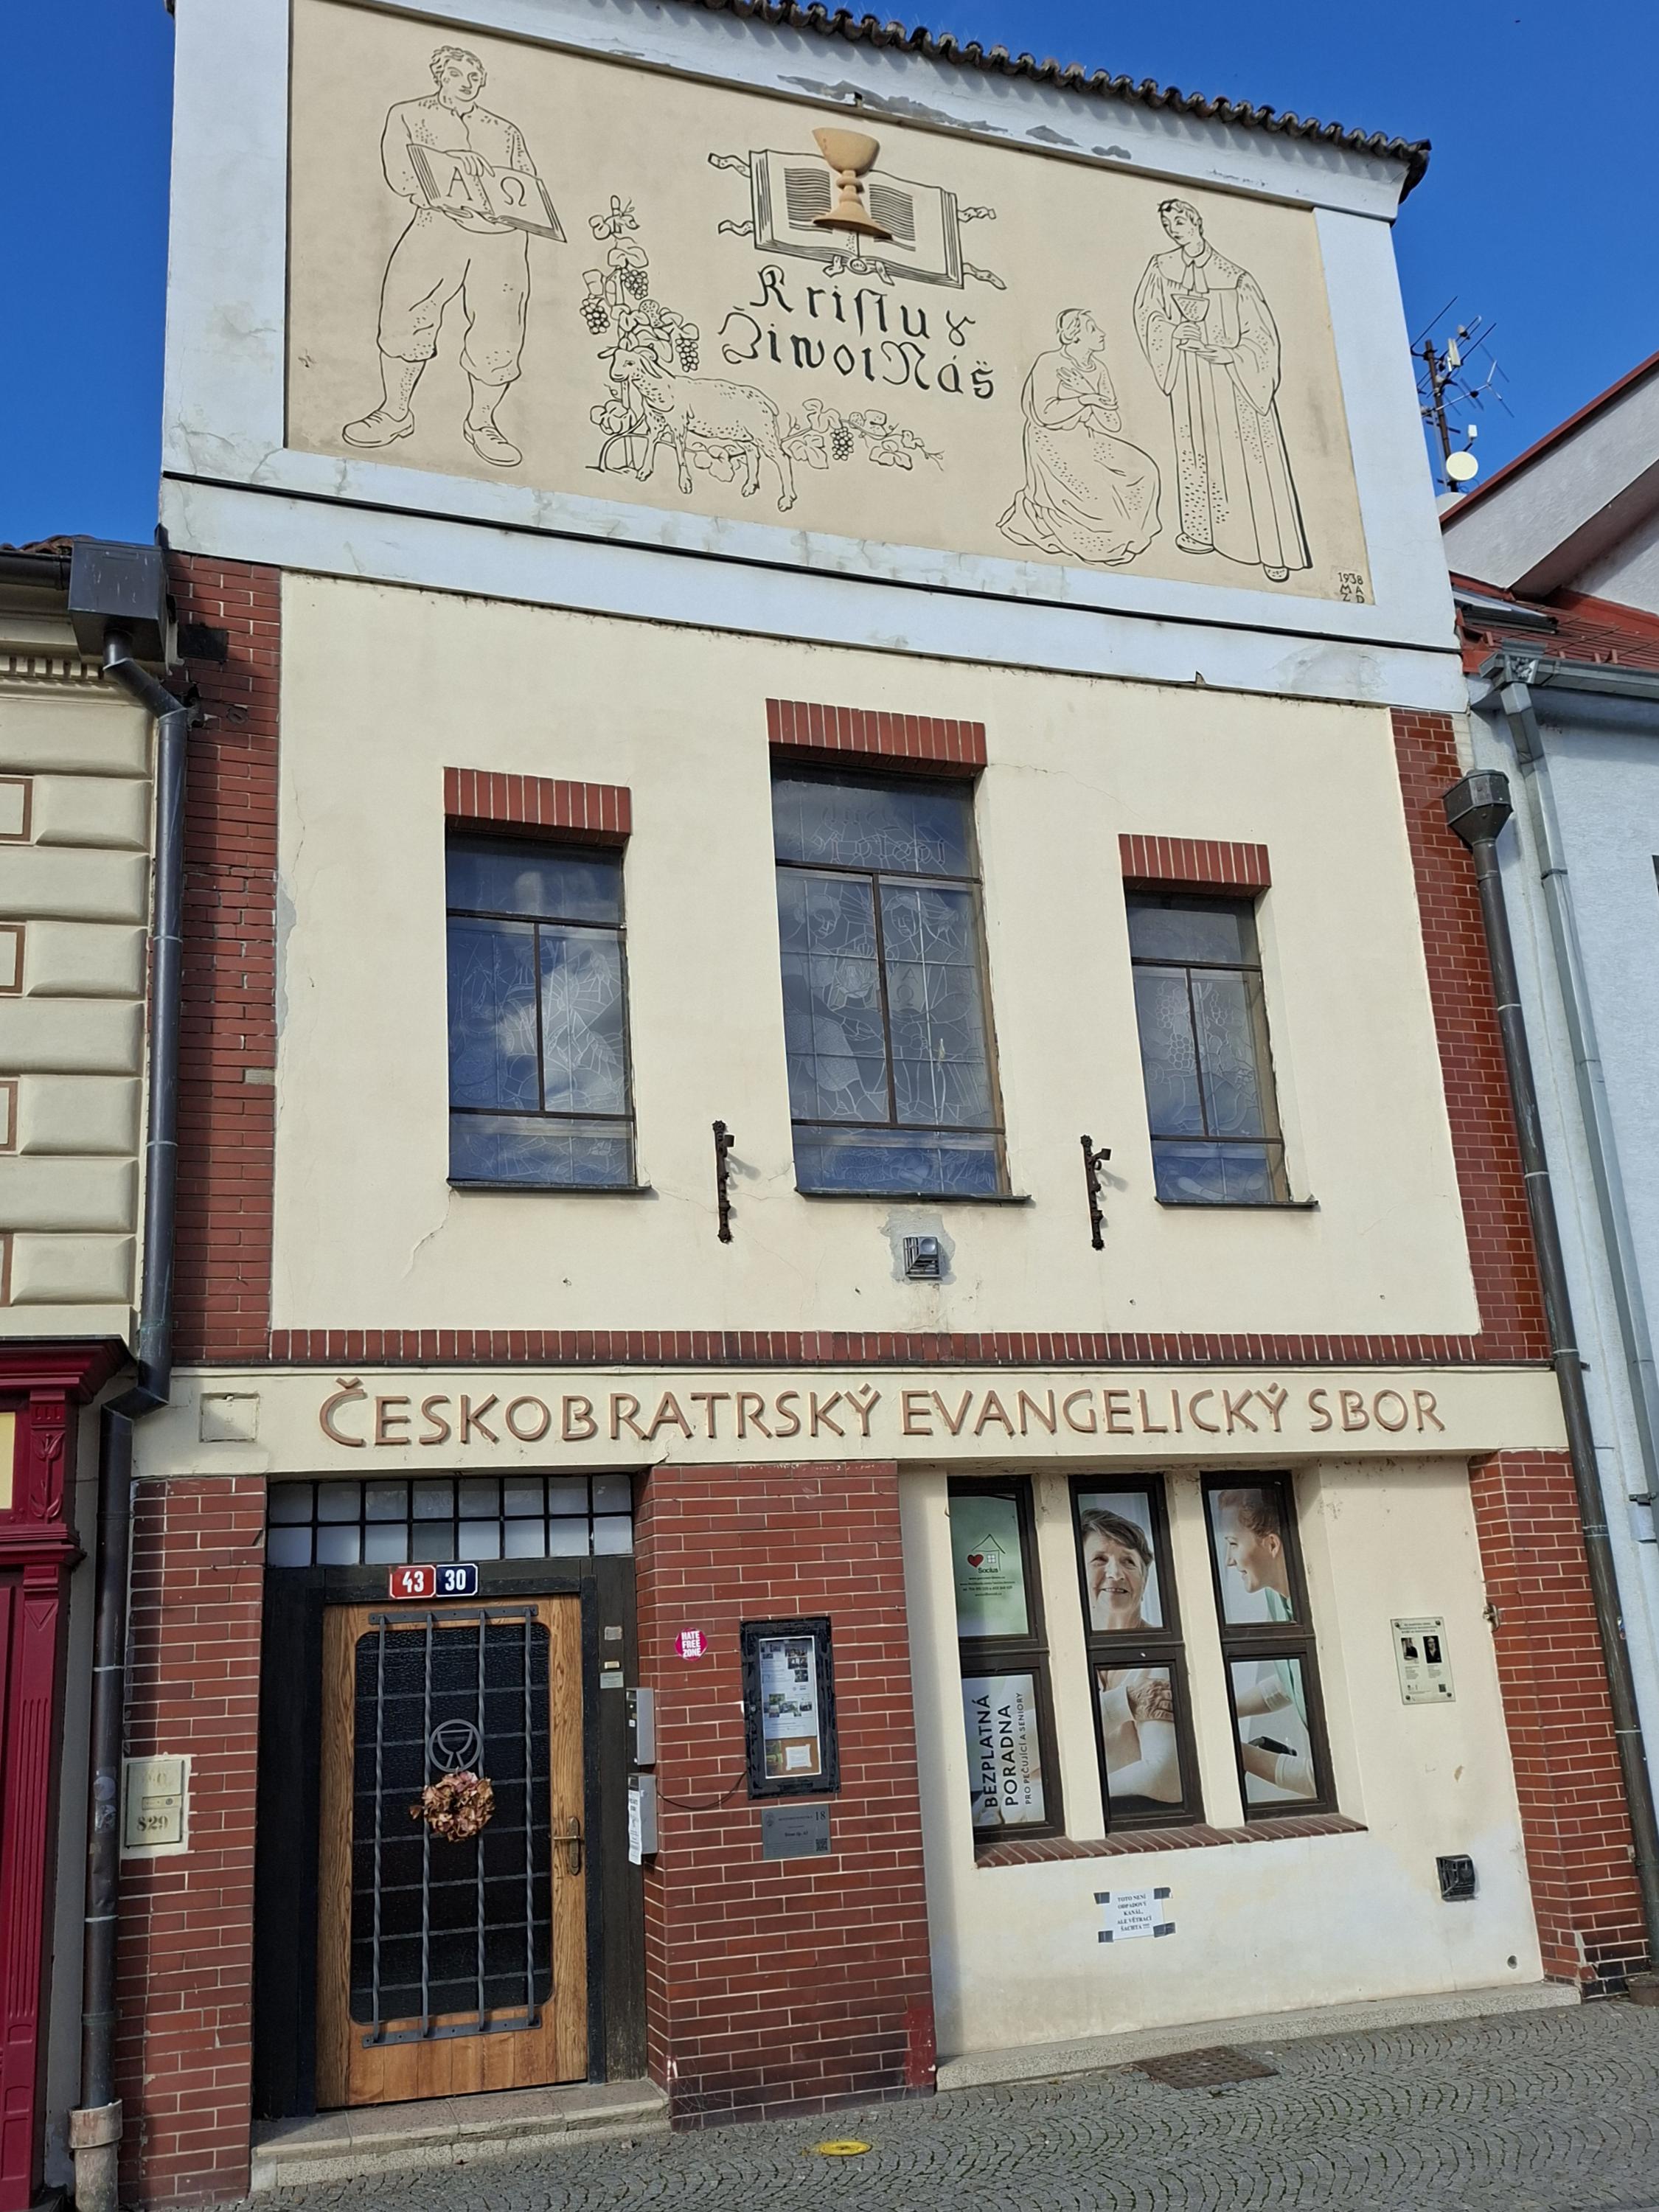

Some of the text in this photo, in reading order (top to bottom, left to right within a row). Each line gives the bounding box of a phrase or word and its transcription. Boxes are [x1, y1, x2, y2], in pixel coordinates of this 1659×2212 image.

[445, 166, 473, 202] A
[1337, 571, 1364, 585] 1938
[318, 1375, 1446, 1447] ČESKOBRATRSKÝ EVANGELICKÝ SBOR
[402, 1571, 425, 1593] 43
[445, 1568, 467, 1591] 30
[681, 1630, 700, 1640] HATE
[682, 1639, 701, 1649] FREE
[682, 1648, 701, 1658] ZONE
[1016, 1692, 1026, 1732] SENIORY
[1020, 1733, 1026, 1741] A
[972, 1694, 998, 1809] BEZPLATNÁ
[998, 1705, 1019, 1806] PORADNA
[815, 1810, 826, 1821] 18
